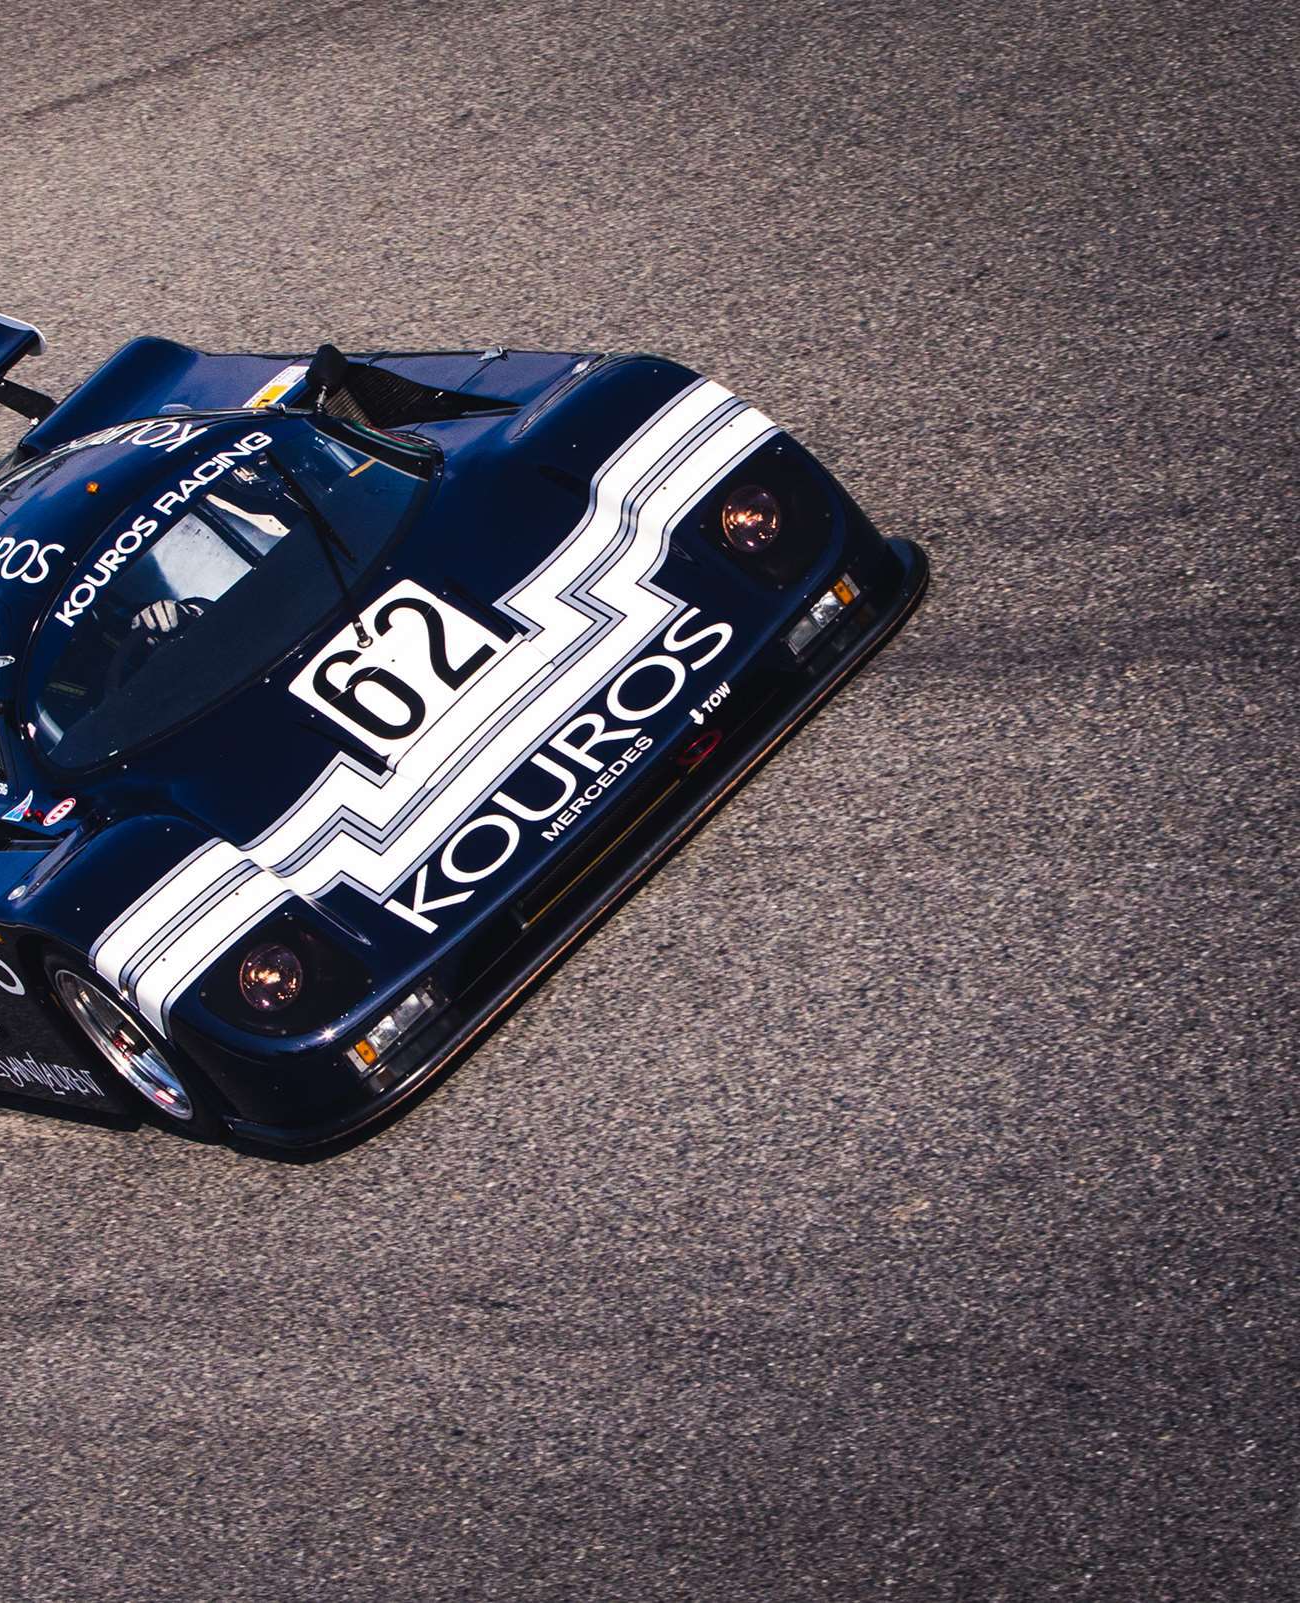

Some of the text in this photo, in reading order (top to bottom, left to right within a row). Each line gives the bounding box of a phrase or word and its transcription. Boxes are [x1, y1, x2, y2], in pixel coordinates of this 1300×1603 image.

[54, 431, 273, 628] KOUROS RACING
[312, 597, 497, 740] 62
[701, 681, 731, 713] TOW
[384, 606, 733, 934] KOUROS
[541, 735, 654, 842] MERCEDES
